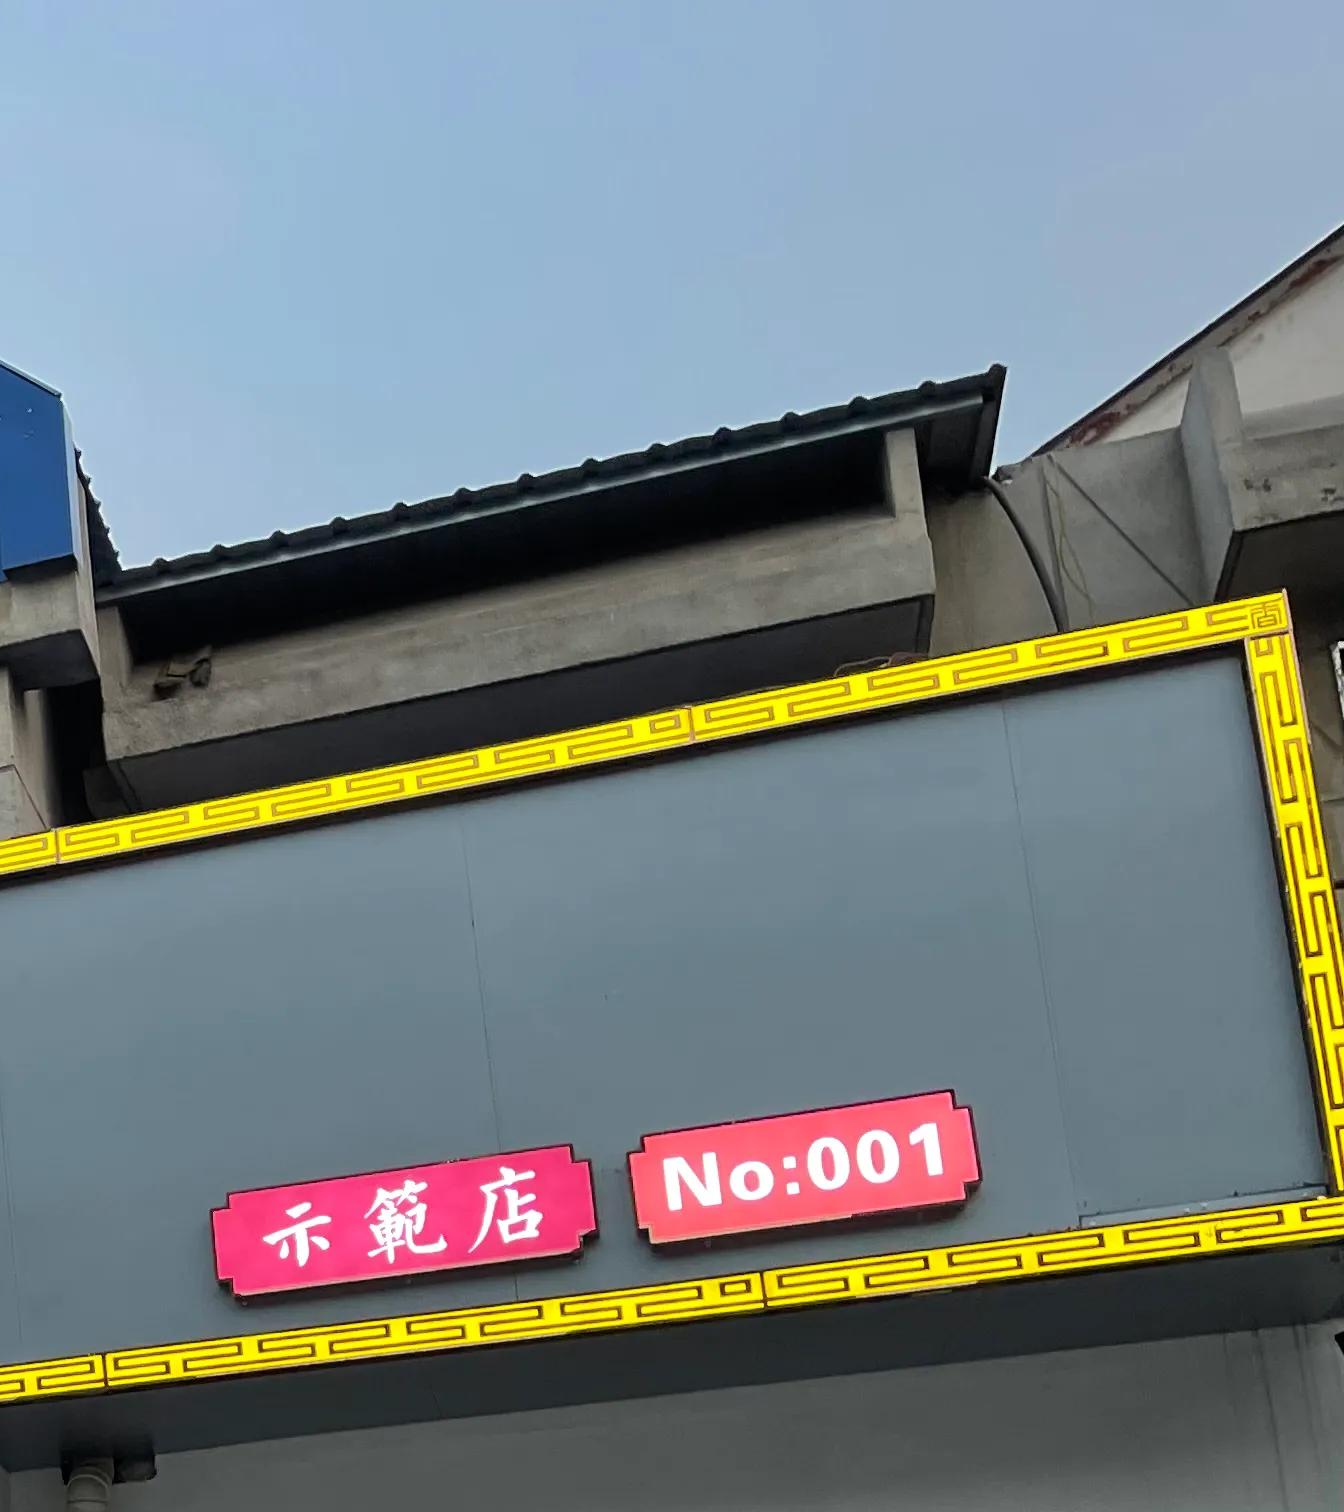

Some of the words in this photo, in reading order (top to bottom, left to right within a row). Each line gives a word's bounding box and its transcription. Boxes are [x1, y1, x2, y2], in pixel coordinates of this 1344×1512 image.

[662, 1121, 945, 1212] No:001
[261, 1165, 544, 1267] 示範店
